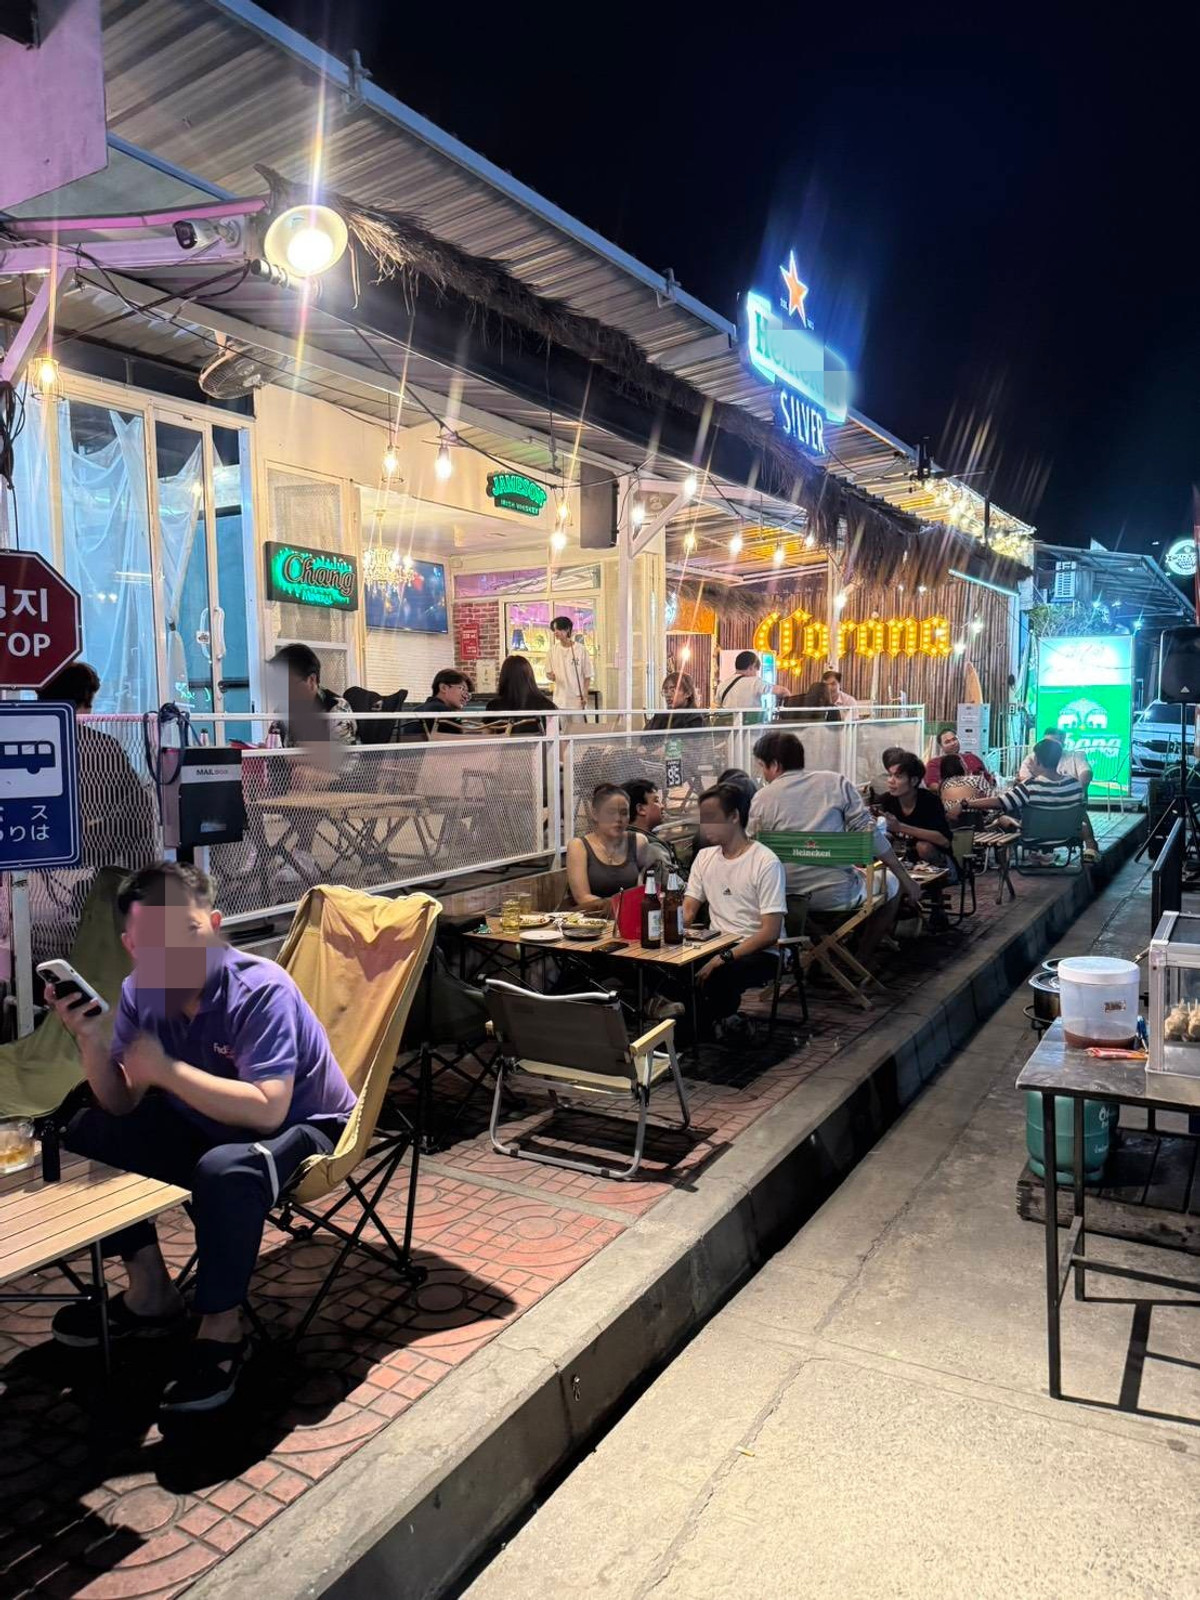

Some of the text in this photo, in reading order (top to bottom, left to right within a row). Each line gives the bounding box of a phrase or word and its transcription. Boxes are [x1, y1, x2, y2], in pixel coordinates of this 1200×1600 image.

[780, 390, 826, 455] SILVER
[283, 552, 355, 597] Chang
[752, 607, 953, 677] Corona
[1063, 732, 1121, 758] hang
[792, 848, 831, 857] Heineken
